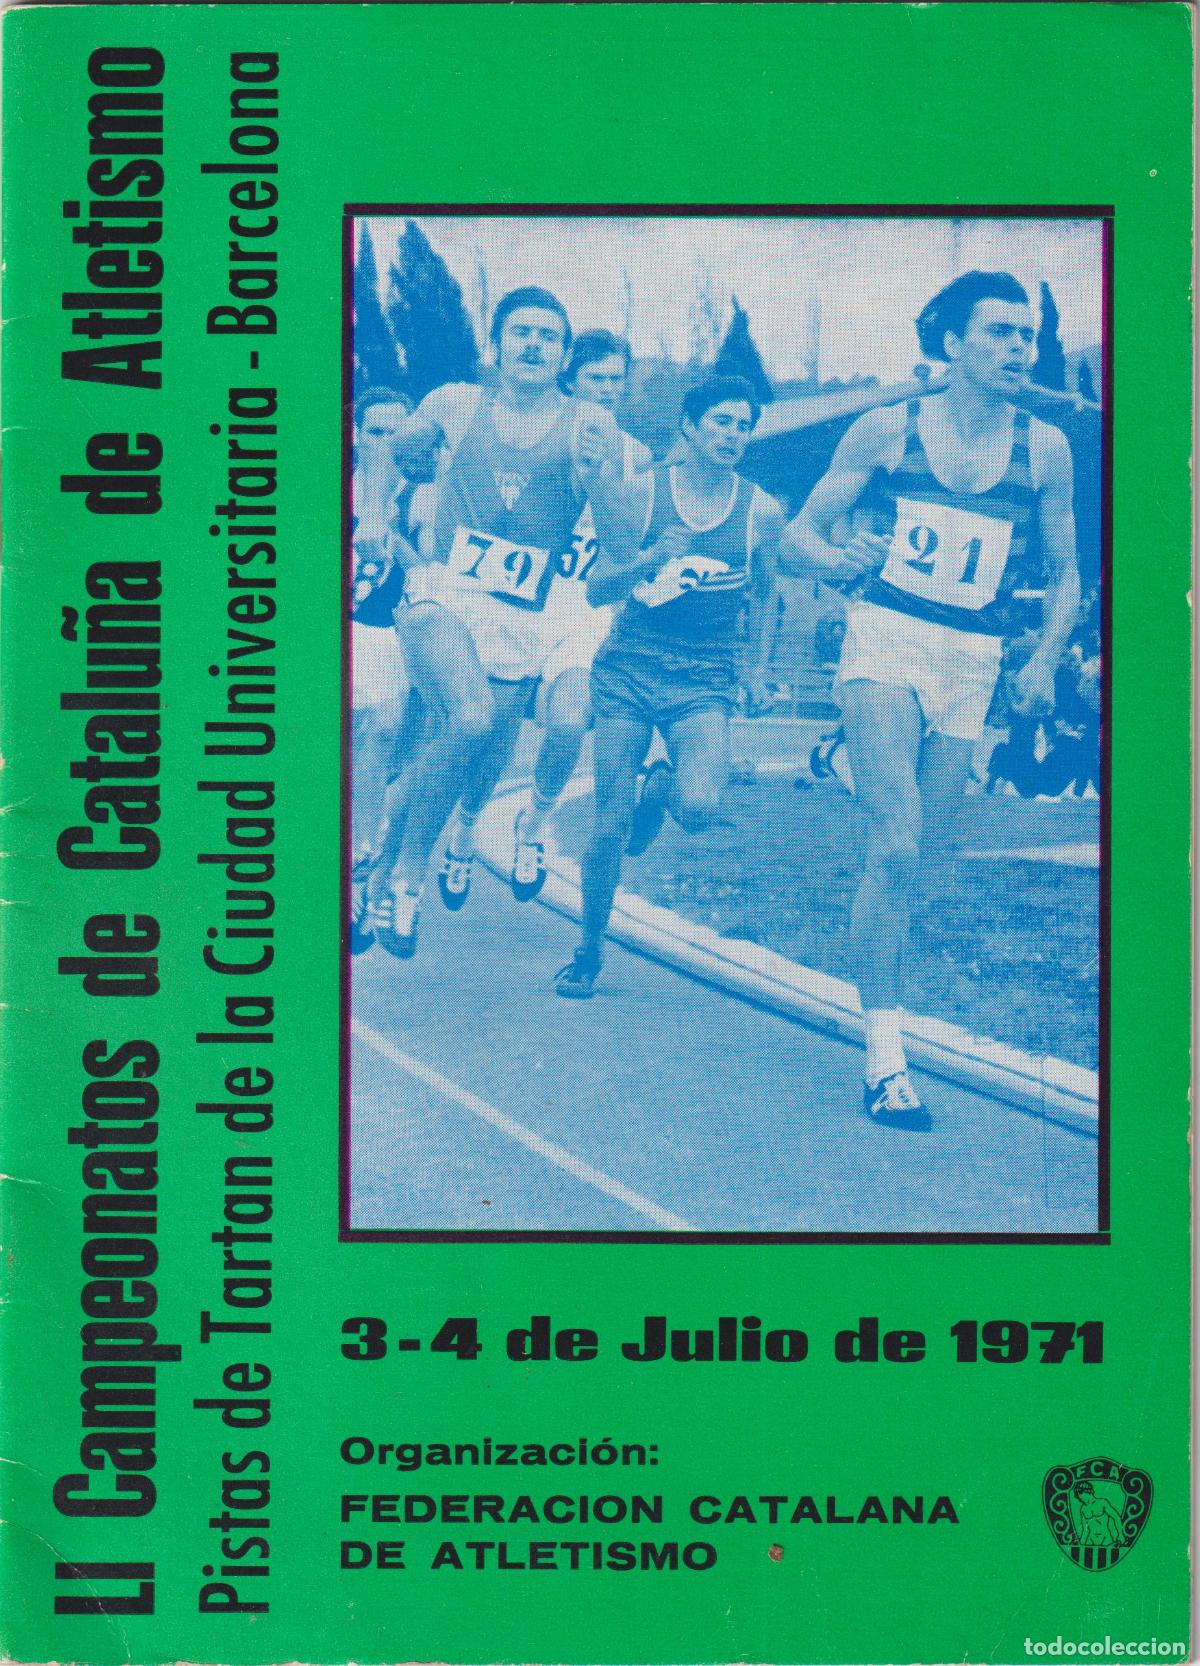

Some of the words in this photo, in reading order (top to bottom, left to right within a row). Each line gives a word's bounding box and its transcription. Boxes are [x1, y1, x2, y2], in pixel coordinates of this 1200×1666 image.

[61, 47, 165, 389] Atletismo
[201, 52, 279, 334] Barcelona
[60, 433, 163, 514] de
[205, 388, 277, 755] Universitaria
[460, 534, 534, 590] 79
[906, 526, 982, 585] 21
[57, 561, 162, 870] Cataluña
[197, 781, 275, 975] Ciudad
[58, 914, 160, 997] de
[196, 997, 274, 1043] la
[196, 1068, 274, 1132] de
[53, 1040, 181, 1517] Campeonatos
[201, 1157, 272, 1343] Tartan
[507, 1316, 598, 1361] de
[622, 1316, 808, 1362] Julio
[835, 1317, 925, 1363] de
[951, 1320, 1103, 1364] 1971
[193, 1363, 271, 1428] de
[341, 1437, 658, 1471] Organización:
[199, 1451, 270, 1613] Pistas
[341, 1495, 662, 1523] FEDERACION
[690, 1496, 959, 1524] CATALANA
[54, 1562, 154, 1615] LI
[341, 1541, 405, 1569] DE
[431, 1542, 717, 1571] ATLETISMO
